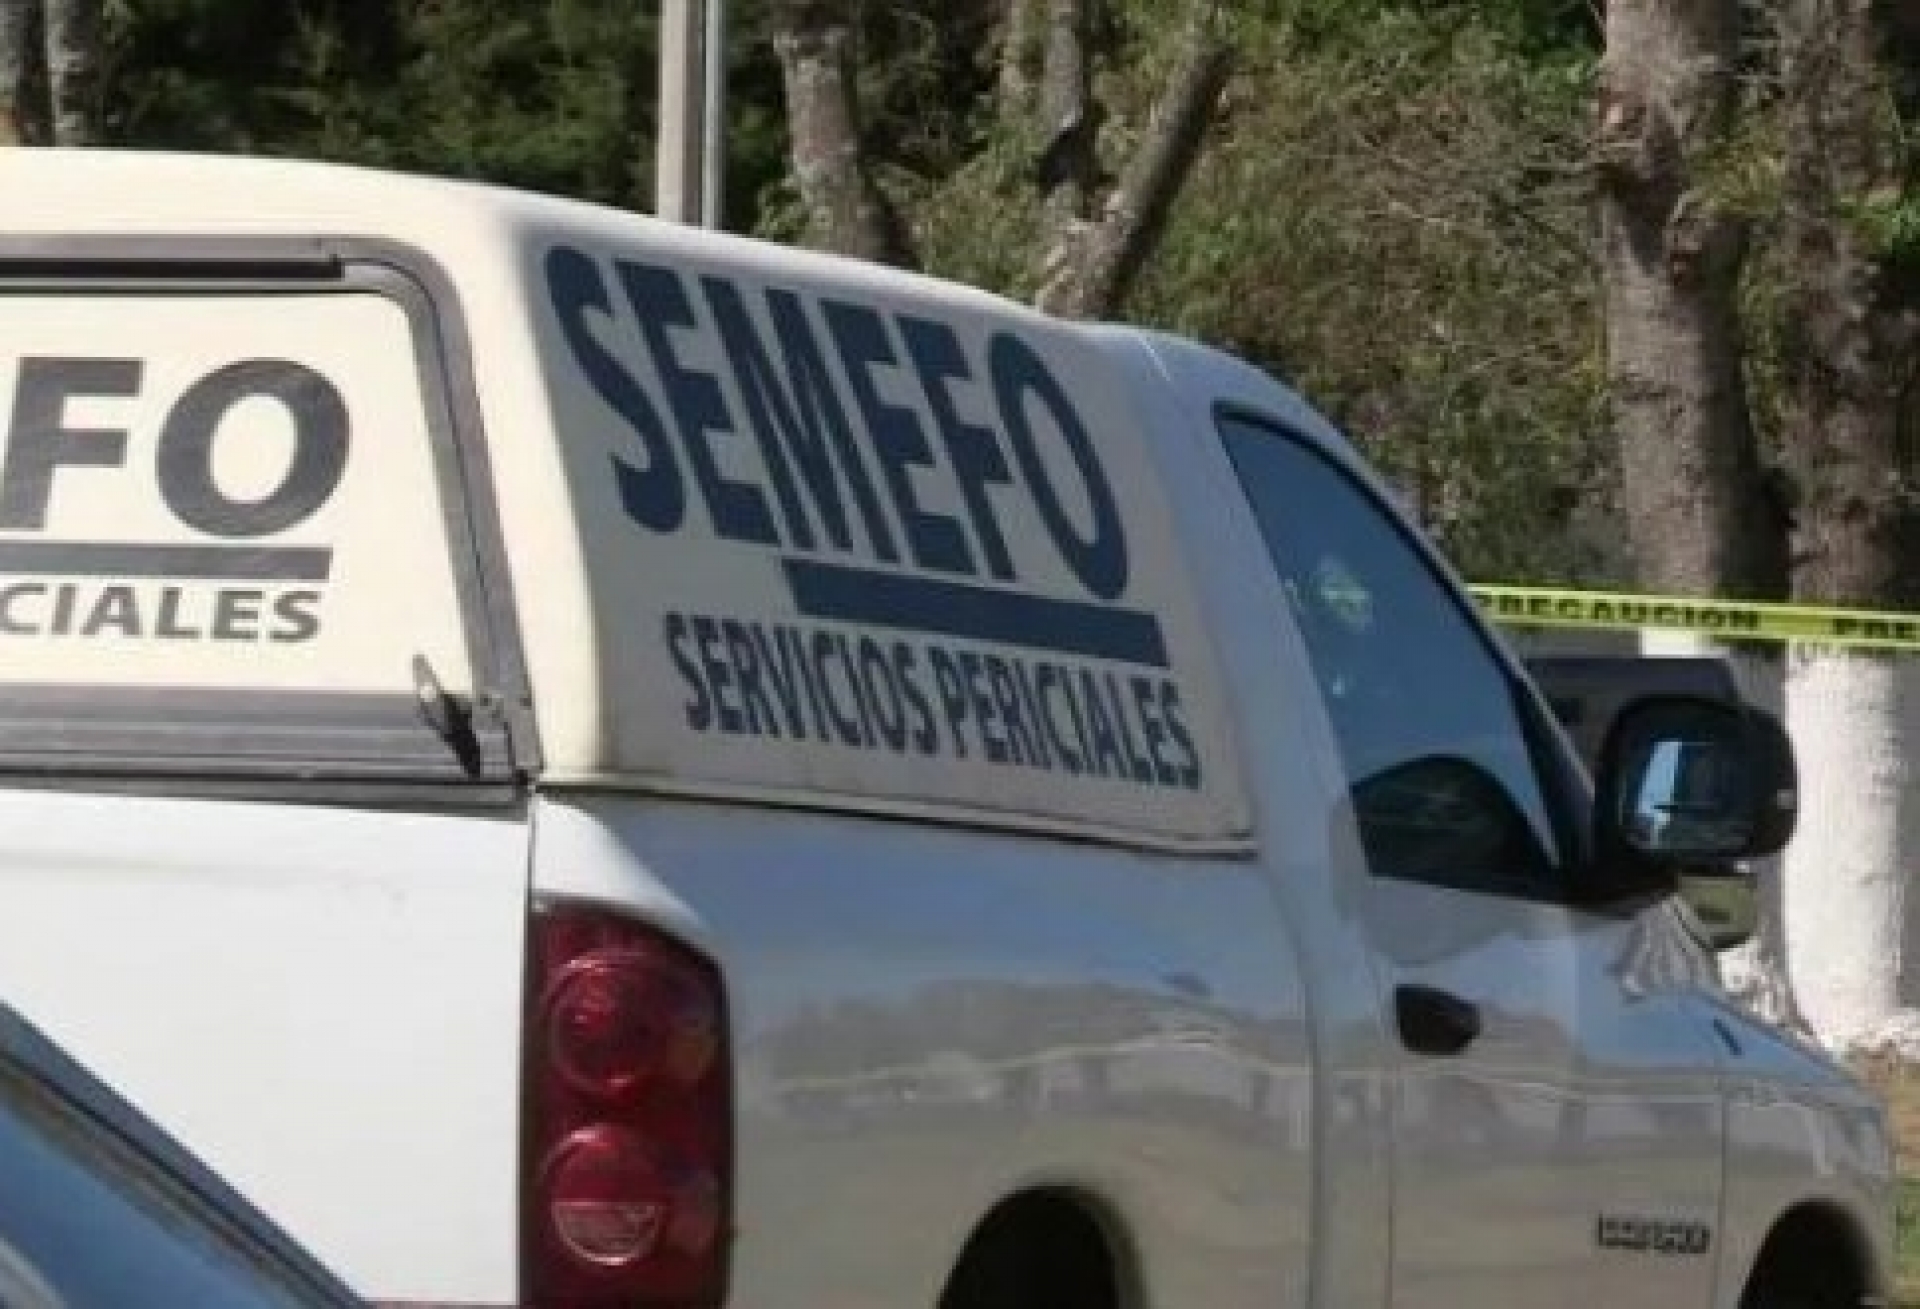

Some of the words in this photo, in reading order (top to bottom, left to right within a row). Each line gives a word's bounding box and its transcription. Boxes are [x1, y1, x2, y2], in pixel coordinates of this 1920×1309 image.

[0, 356, 352, 539] FO
[545, 246, 1129, 600] SEMEFO
[0, 582, 325, 642] CIALES
[664, 612, 938, 755] SERVICIOS
[928, 646, 1202, 790] PERICIALES
